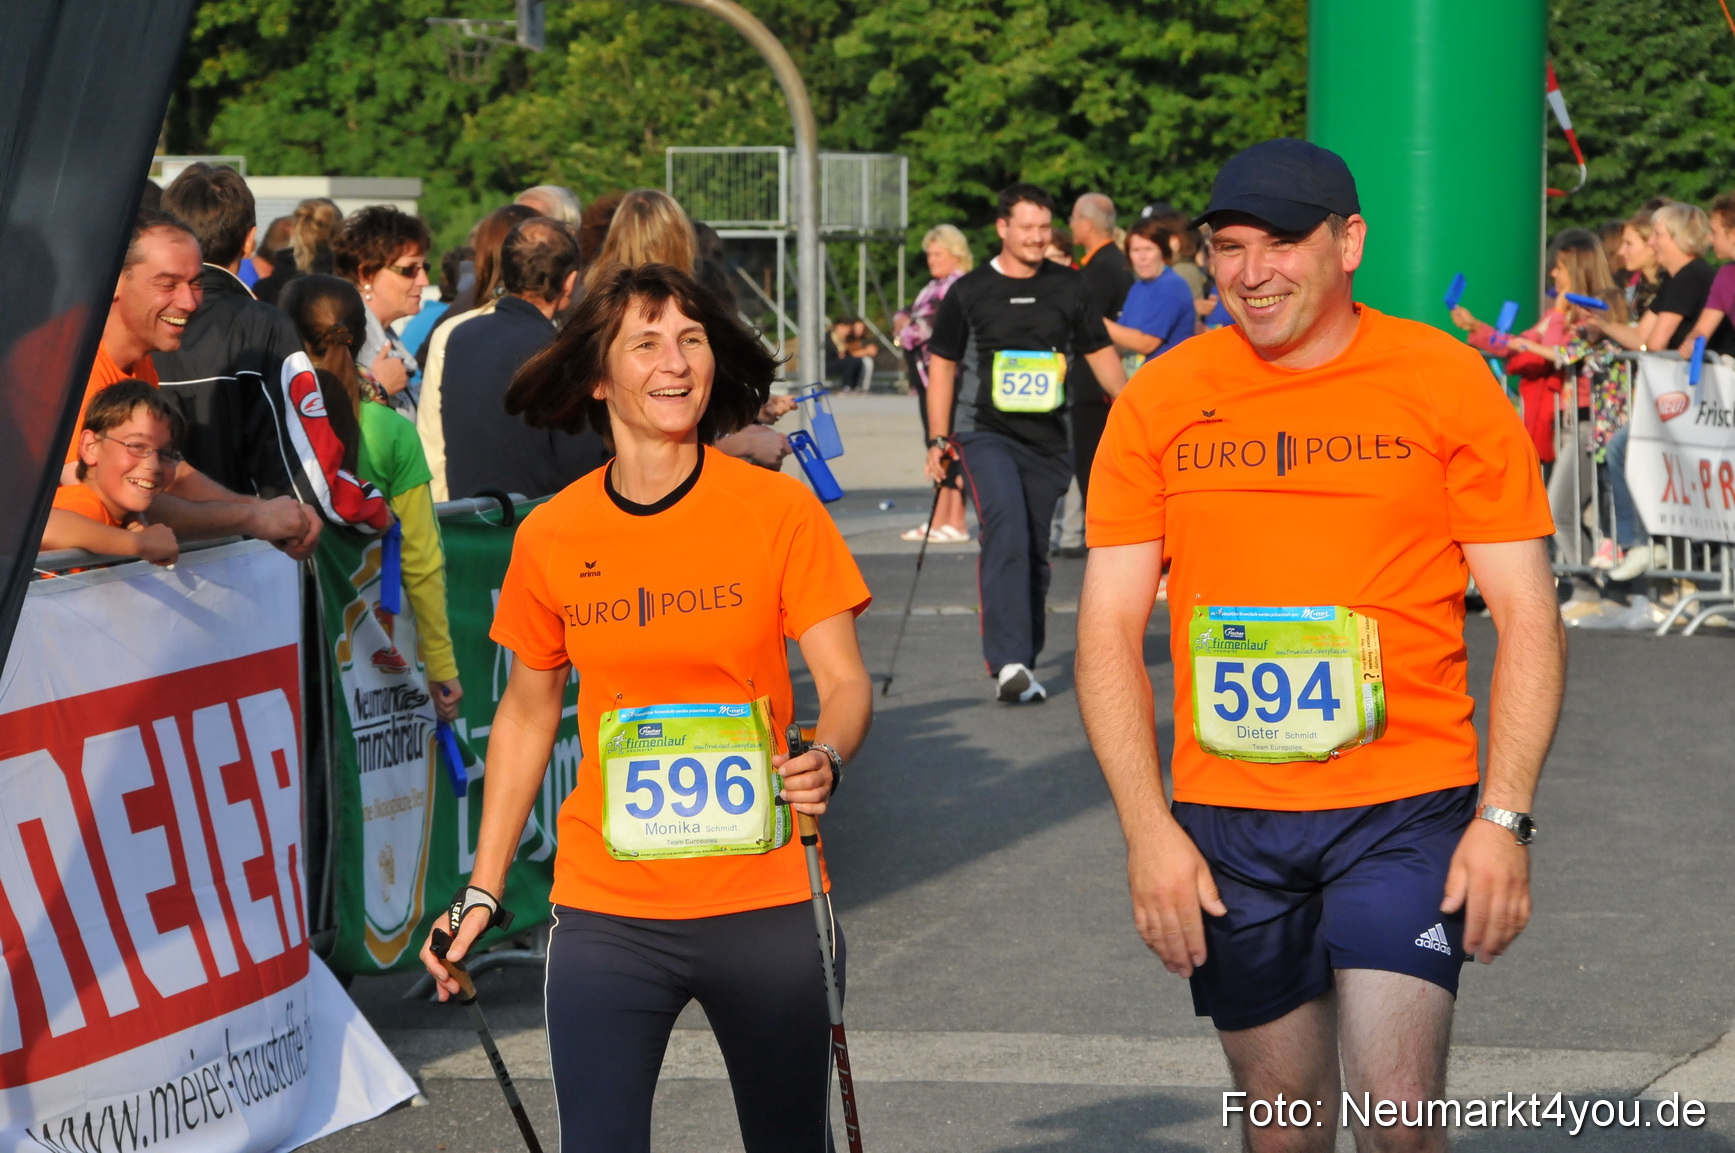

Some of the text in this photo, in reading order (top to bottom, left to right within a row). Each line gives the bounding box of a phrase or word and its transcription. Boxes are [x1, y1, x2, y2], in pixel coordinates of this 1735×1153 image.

[1002, 373, 1049, 396] 529
[1177, 434, 1413, 472] EURO POLES
[579, 570, 601, 578] erima
[563, 582, 743, 627] EURO POLES
[1213, 638, 1269, 651] firmenlauf
[1213, 660, 1341, 724] 594
[1236, 725, 1318, 740] Dieter Schmidt
[626, 735, 686, 749] firmenlauf
[1252, 743, 1303, 752] Team Europoles
[625, 755, 755, 819] 596
[645, 821, 738, 836] Monika Schmidt
[666, 837, 718, 846] Team Europoles
[1414, 938, 1452, 956] adidas
[833, 1042, 857, 1143] Flash
